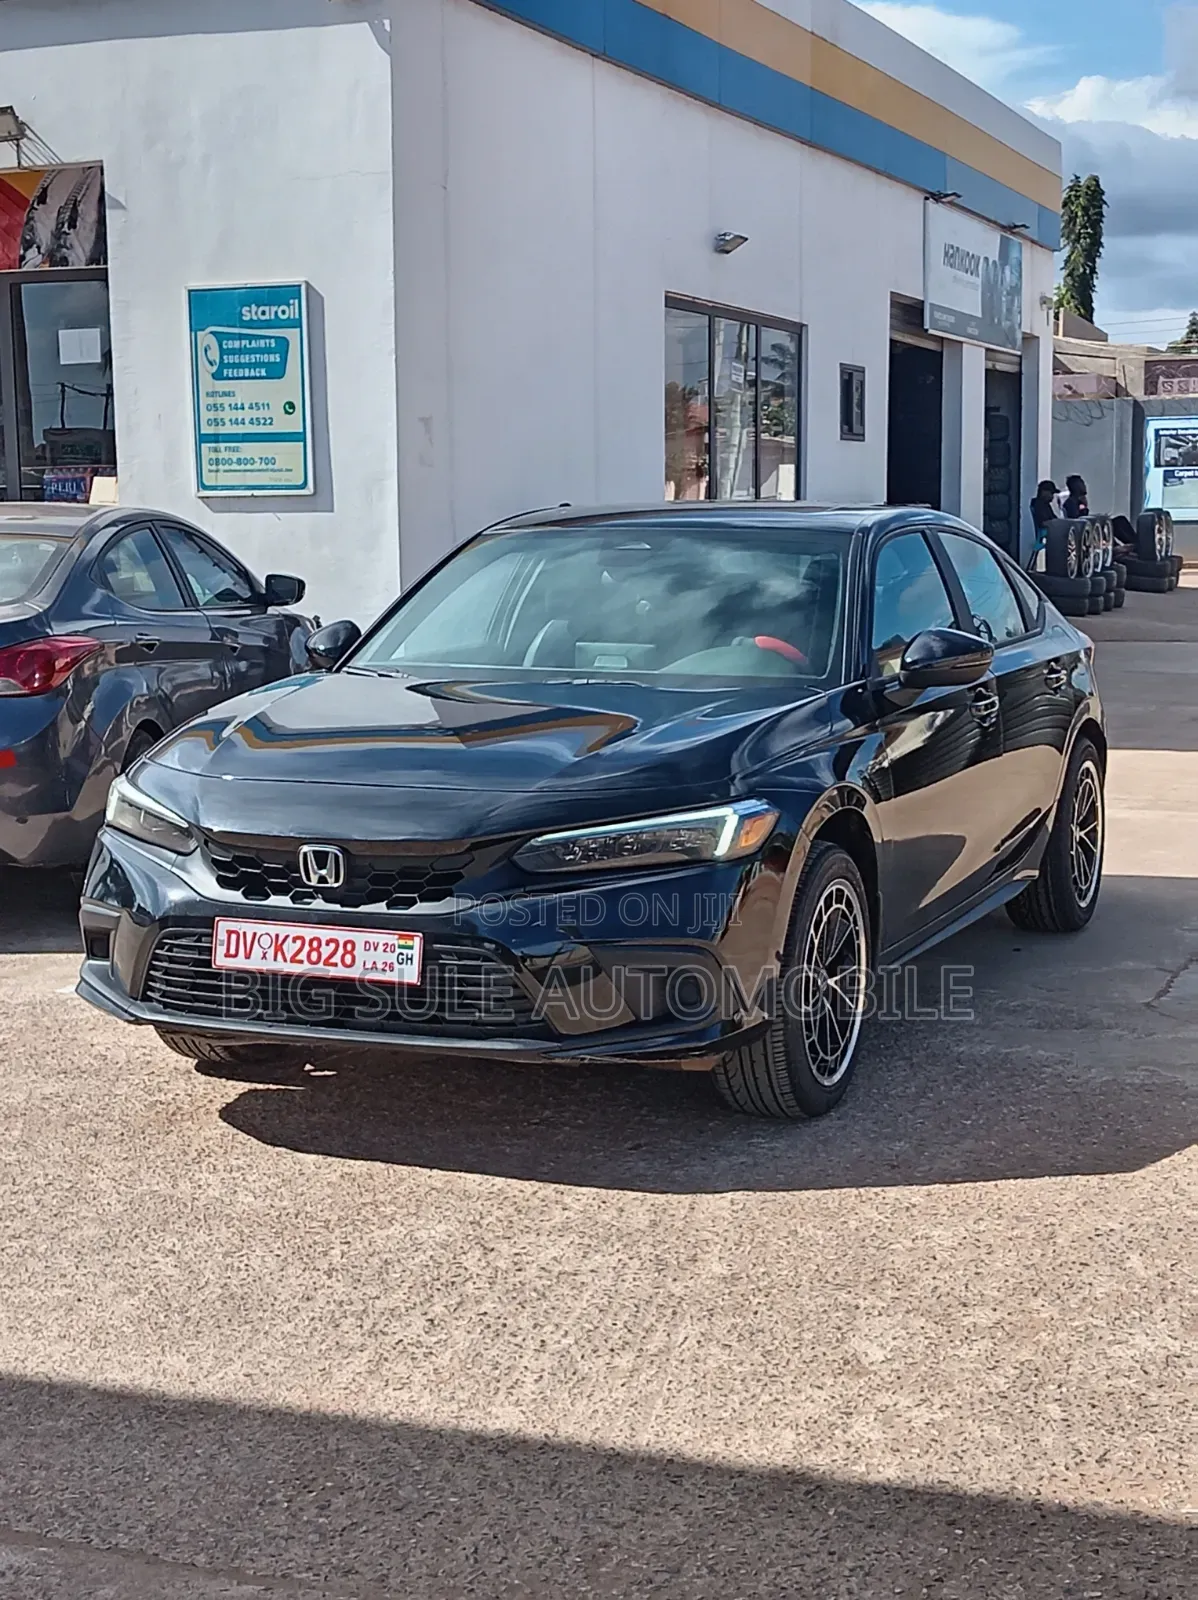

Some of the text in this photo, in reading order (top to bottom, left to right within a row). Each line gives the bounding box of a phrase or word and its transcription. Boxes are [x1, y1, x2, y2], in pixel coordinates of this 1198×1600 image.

[241, 299, 300, 321] staroil
[222, 338, 276, 349] COMPLAINTS
[223, 353, 281, 364] SUGGESTIONS
[223, 368, 267, 378] FEEDBACK
[206, 402, 271, 412] 055 144 4511
[206, 417, 274, 427] 055 144 4522
[208, 456, 277, 467] 0800-800-700
[224, 928, 357, 969] DV K2828
[363, 940, 396, 954] DV 20
[396, 951, 414, 966] GH
[362, 960, 395, 973] LA 26
